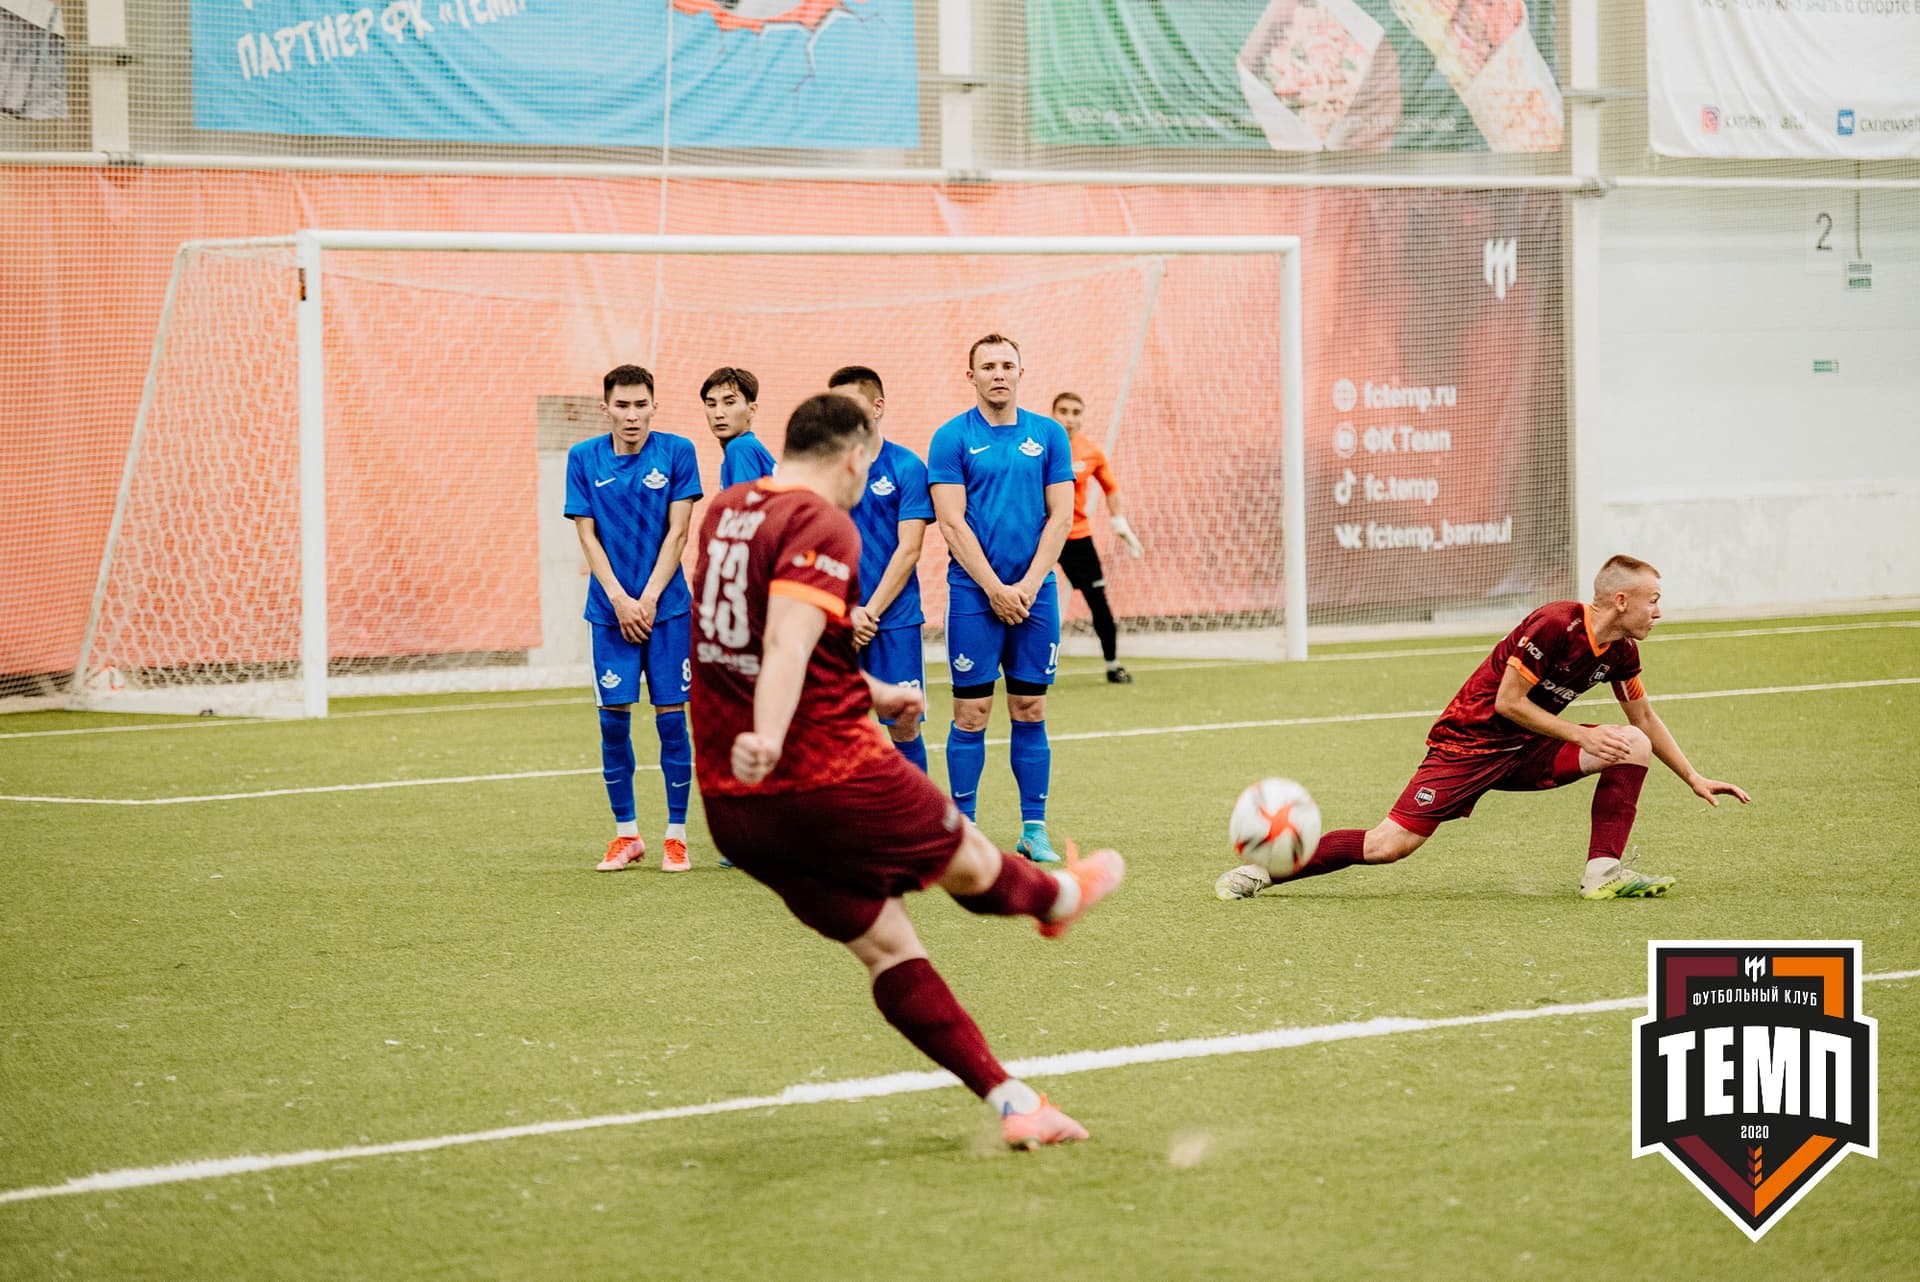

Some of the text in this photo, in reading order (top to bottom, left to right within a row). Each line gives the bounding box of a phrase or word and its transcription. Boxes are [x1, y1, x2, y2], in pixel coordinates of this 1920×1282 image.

[237, 8, 373, 80] ПАРТНЕР
[381, 0, 434, 43] ФК
[1816, 212, 1833, 251] 2
[1364, 382, 1456, 412] fctemp.ru
[1400, 424, 1453, 452] Темп
[1364, 472, 1439, 505] fc.temp
[1366, 515, 1513, 552] fctemp_barnaul
[700, 538, 750, 649] 13
[682, 657, 692, 682] 8
